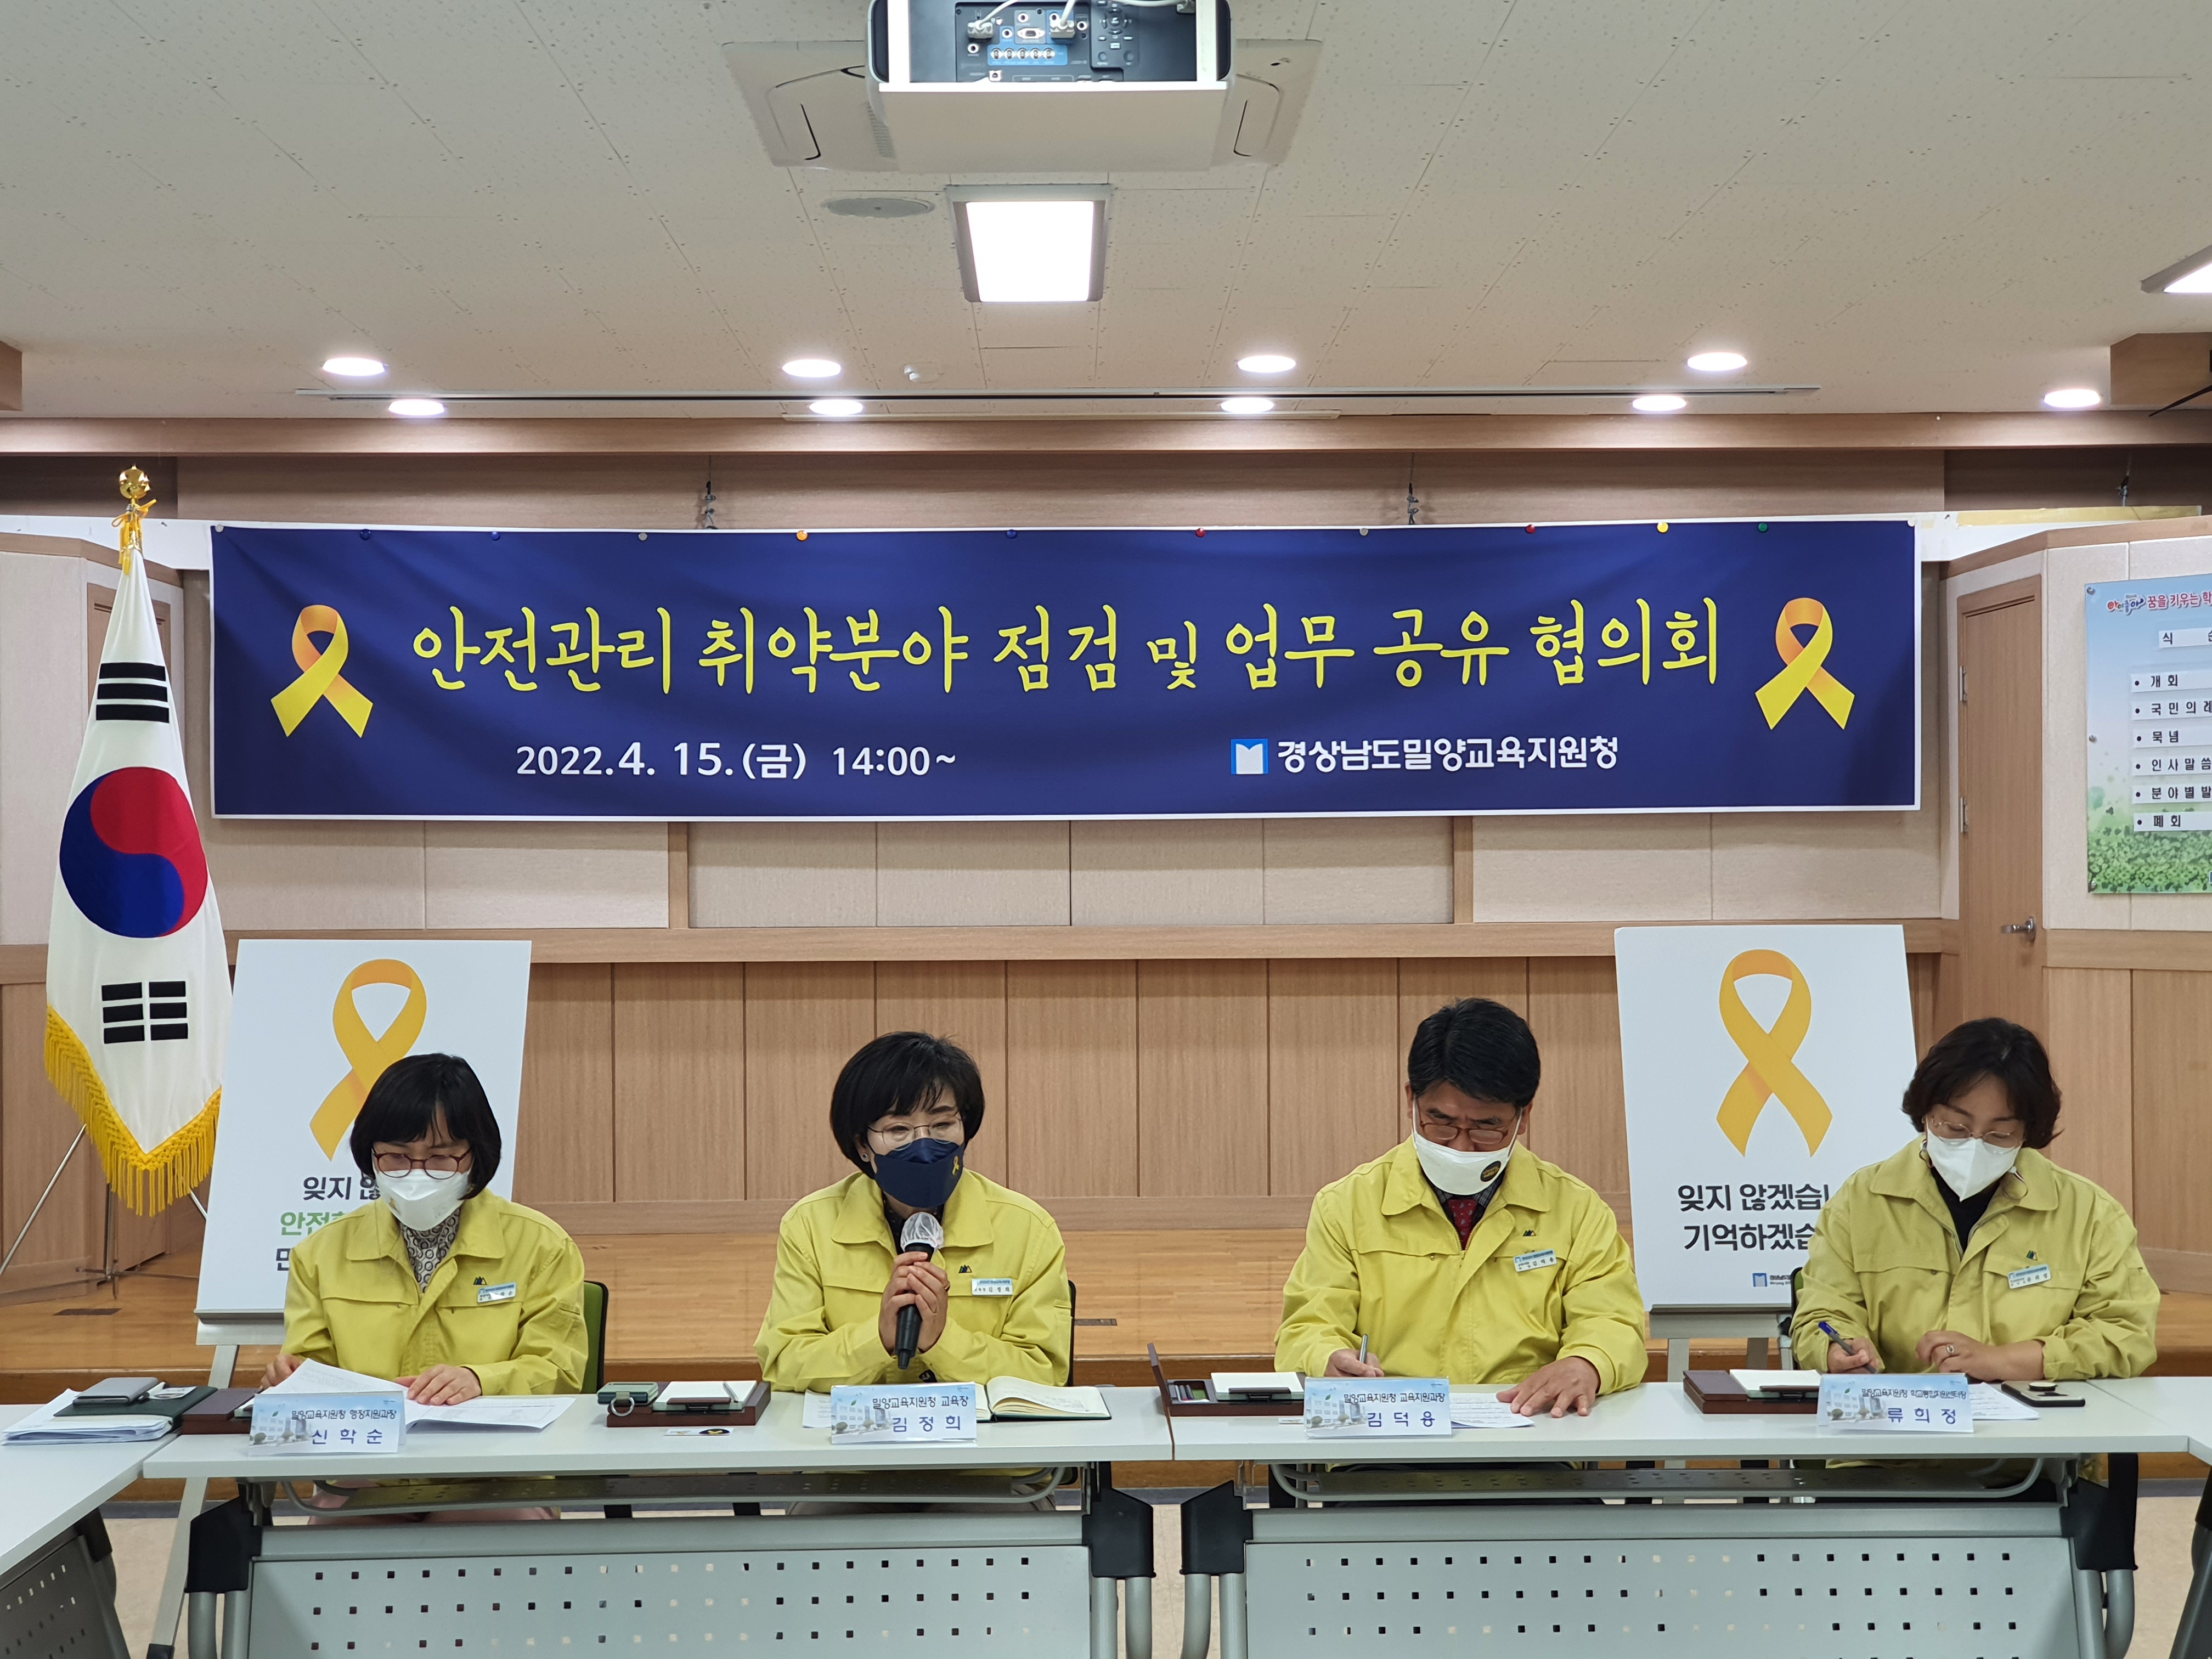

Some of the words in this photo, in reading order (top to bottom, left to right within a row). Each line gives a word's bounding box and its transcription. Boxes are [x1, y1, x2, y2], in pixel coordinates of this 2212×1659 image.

[2147, 595, 2166, 608] 꿈을
[2170, 592, 2198, 606] 키우는
[414, 606, 671, 694] 안전관리
[699, 606, 969, 694] 취약분야
[995, 605, 1117, 692] 점검
[1147, 621, 1197, 690] 및
[1227, 603, 1356, 690] 업무
[1374, 610, 1510, 687] 공유
[1531, 597, 1717, 686] 협의회
[517, 742, 654, 775] 2022.4.
[1278, 736, 1617, 772] 경상남도밀양교육지원청
[303, 1177, 351, 1200] 잊지
[1678, 1185, 1731, 1211] 잊지
[1739, 1184, 1829, 1211] 않겠습
[873, 1396, 936, 1409] 밀양교육지원청
[941, 1395, 969, 1407] 교육장
[1344, 1392, 1396, 1404] 밀양교육지원청
[1400, 1393, 1445, 1403] 교육지원과장
[292, 1409, 346, 1420] 밀양교육지원청
